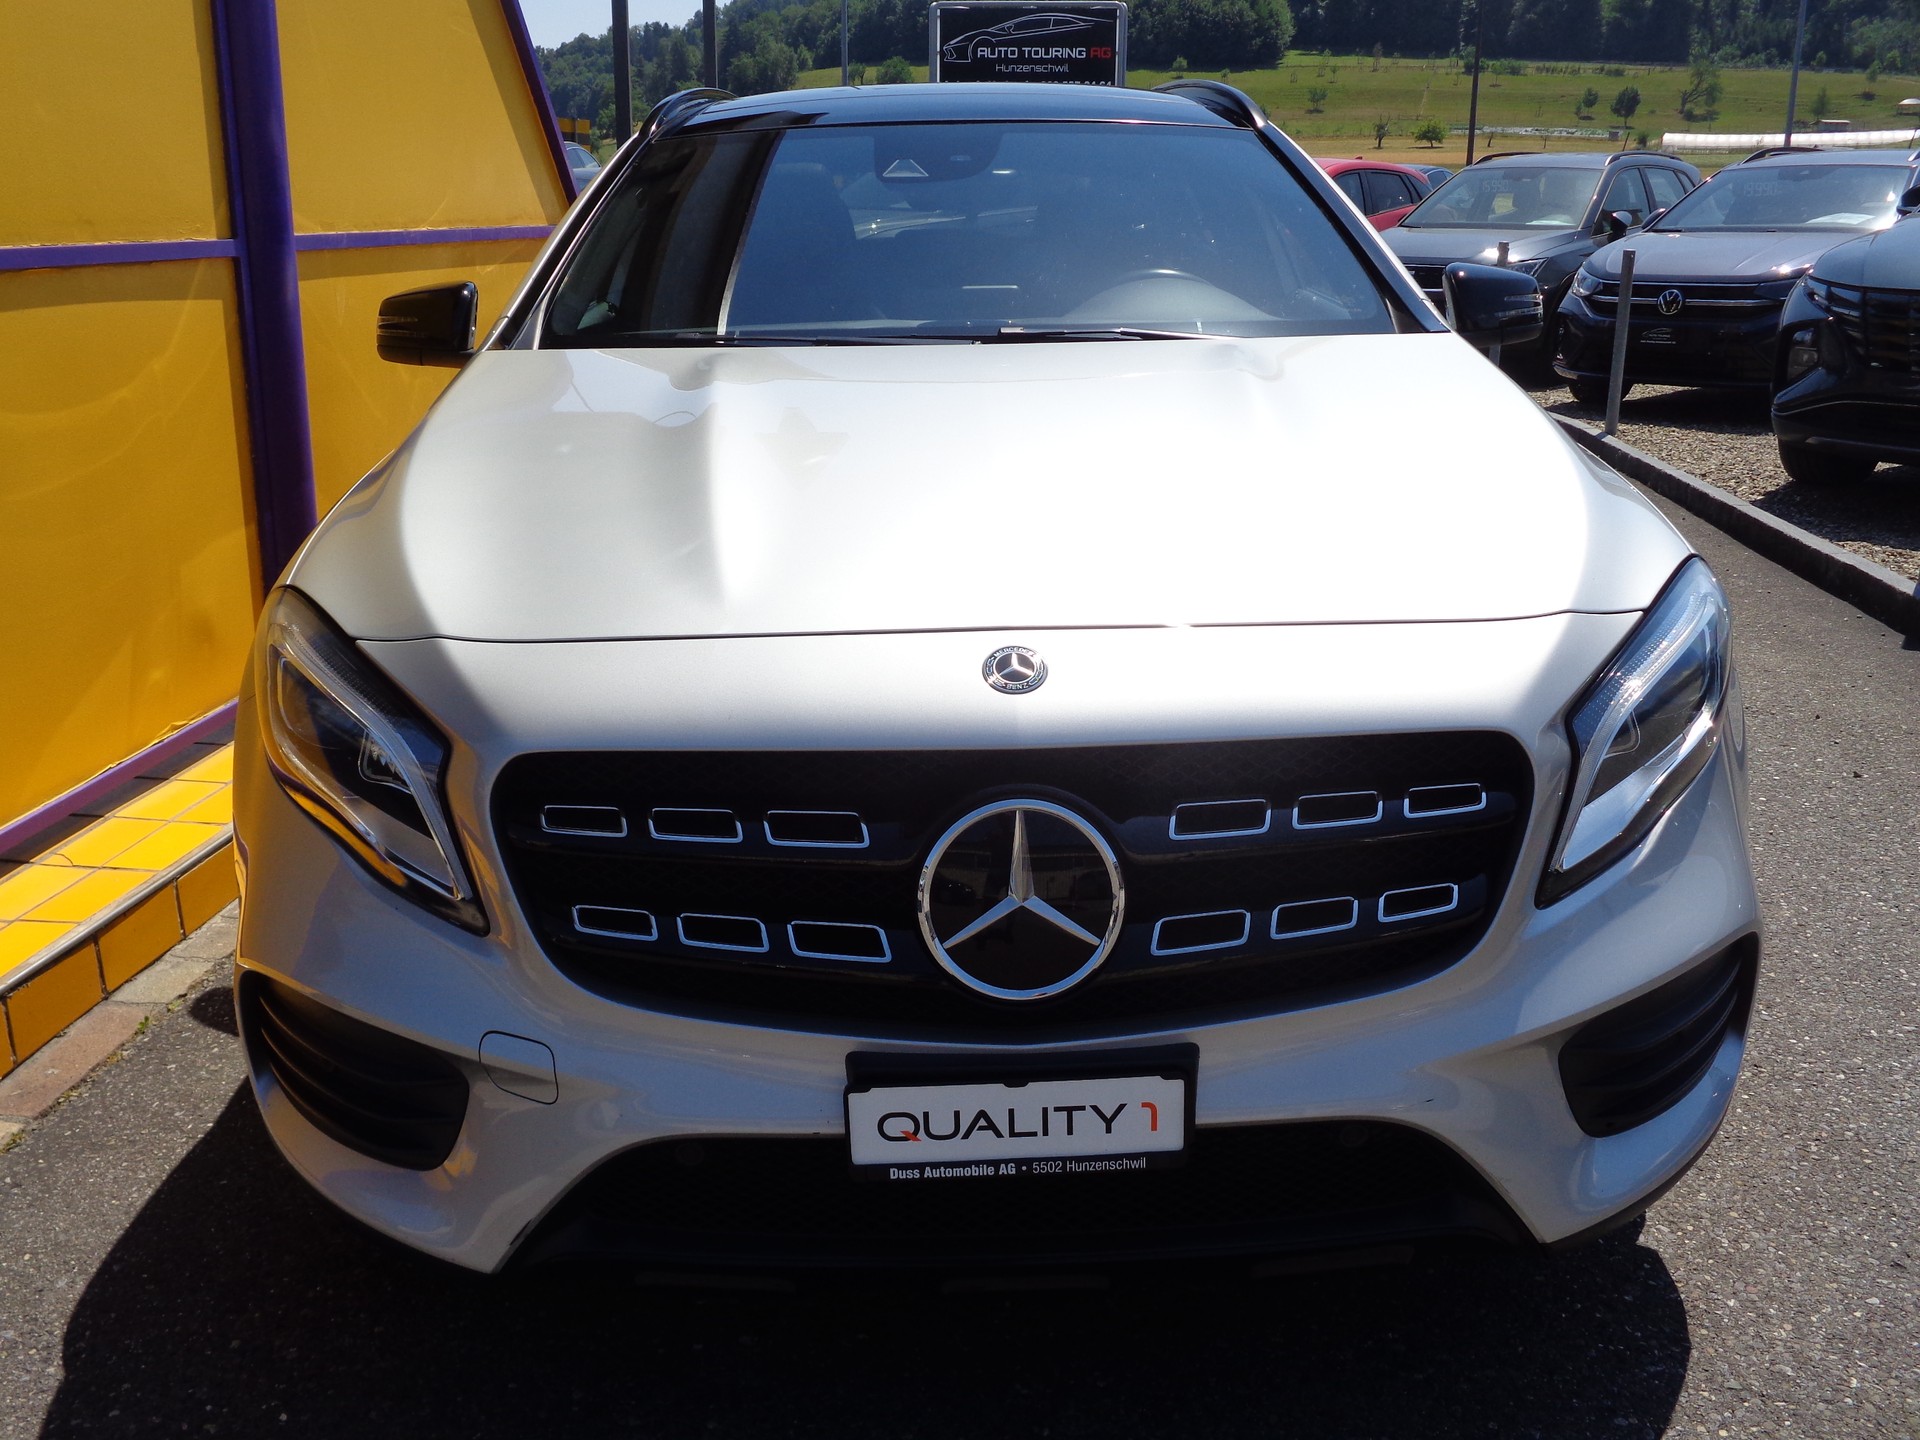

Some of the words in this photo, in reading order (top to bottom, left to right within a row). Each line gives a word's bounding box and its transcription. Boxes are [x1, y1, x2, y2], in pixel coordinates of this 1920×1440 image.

[977, 47, 1018, 59] AUTO
[1022, 47, 1086, 59] TOURING
[1090, 47, 1112, 59] AG
[996, 63, 1069, 73] Hunzenschwil
[877, 1103, 1128, 1142] QUALITY
[889, 1167, 920, 1180] Duss
[923, 1164, 995, 1179] Automobile
[999, 1163, 1016, 1176] AG
[1032, 1160, 1063, 1174] 5502
[1066, 1157, 1146, 1173] Hunzenschwil
